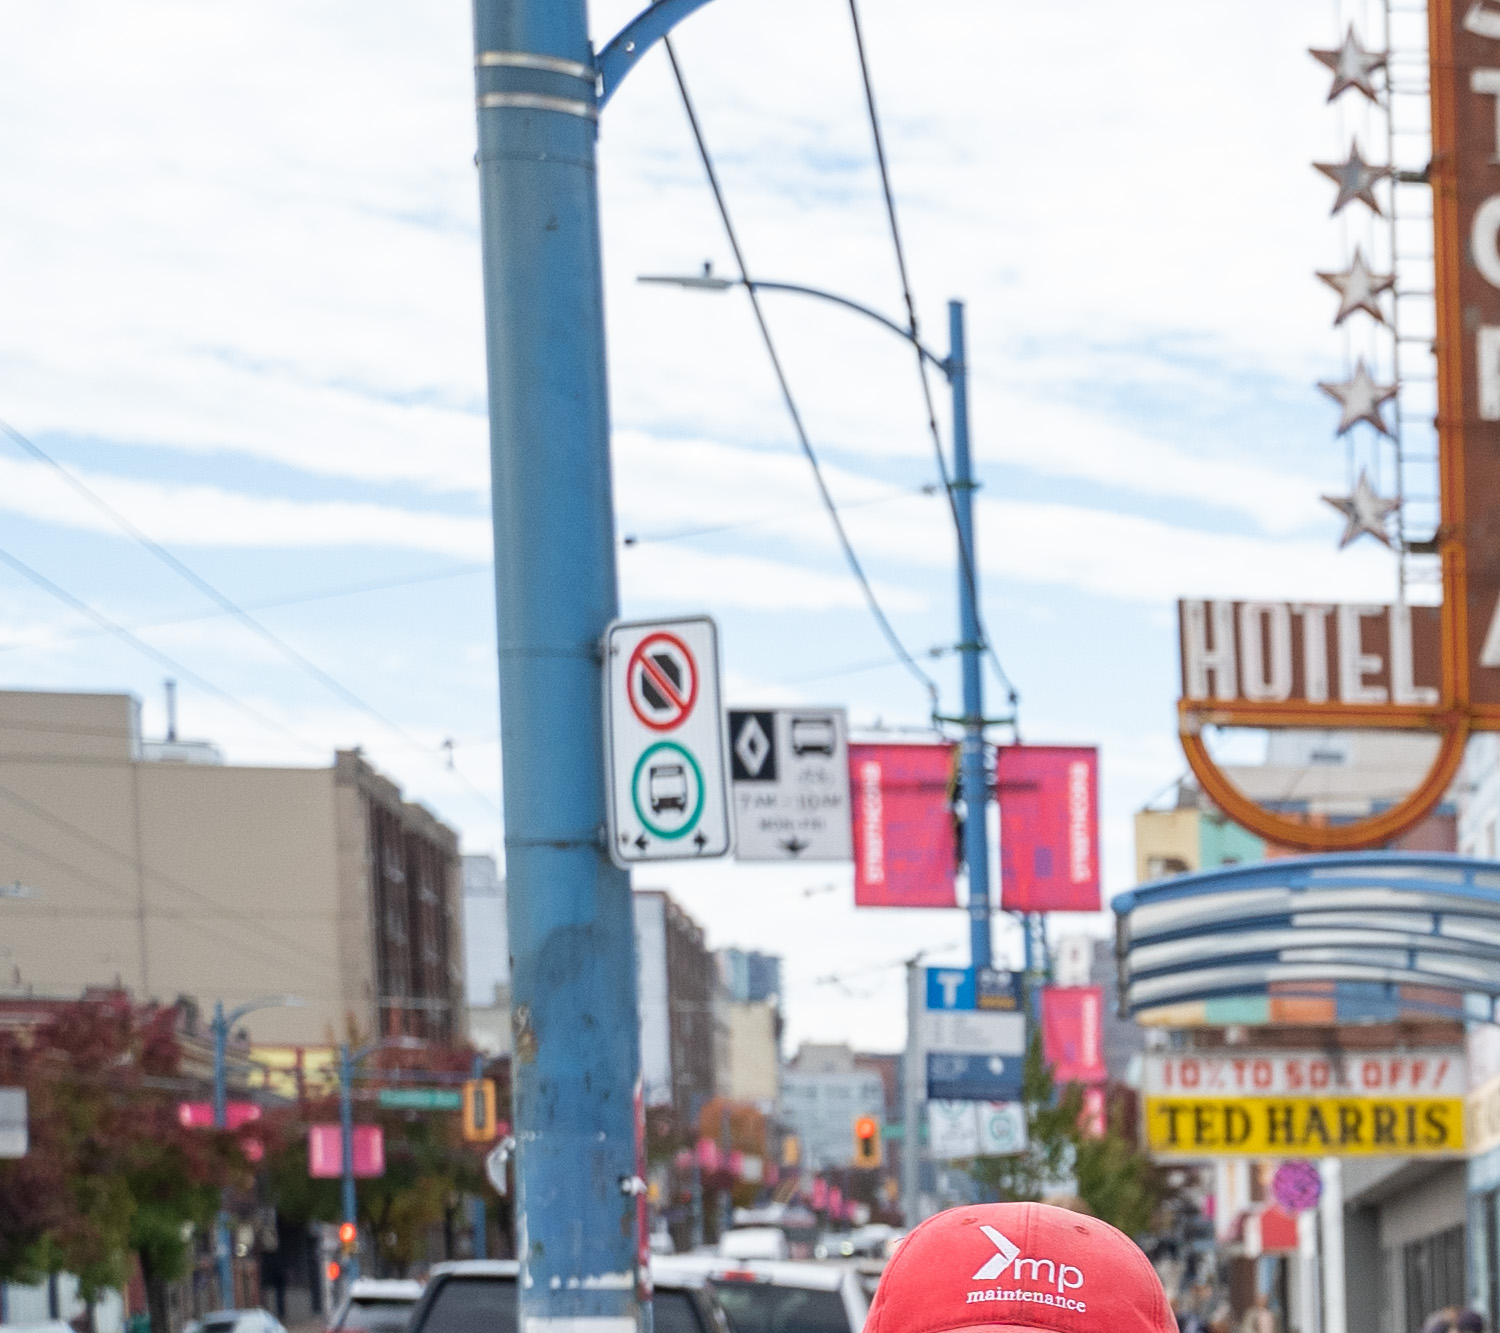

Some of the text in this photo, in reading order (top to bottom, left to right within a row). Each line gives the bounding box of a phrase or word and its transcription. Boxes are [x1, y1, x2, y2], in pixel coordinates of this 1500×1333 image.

[1186, 603, 1440, 705] HOTEL
[1157, 1103, 1253, 1148] TED
[1266, 1102, 1451, 1148] HARRIS
[1013, 1257, 1084, 1293] mp
[966, 1286, 1087, 1313] maintenance
